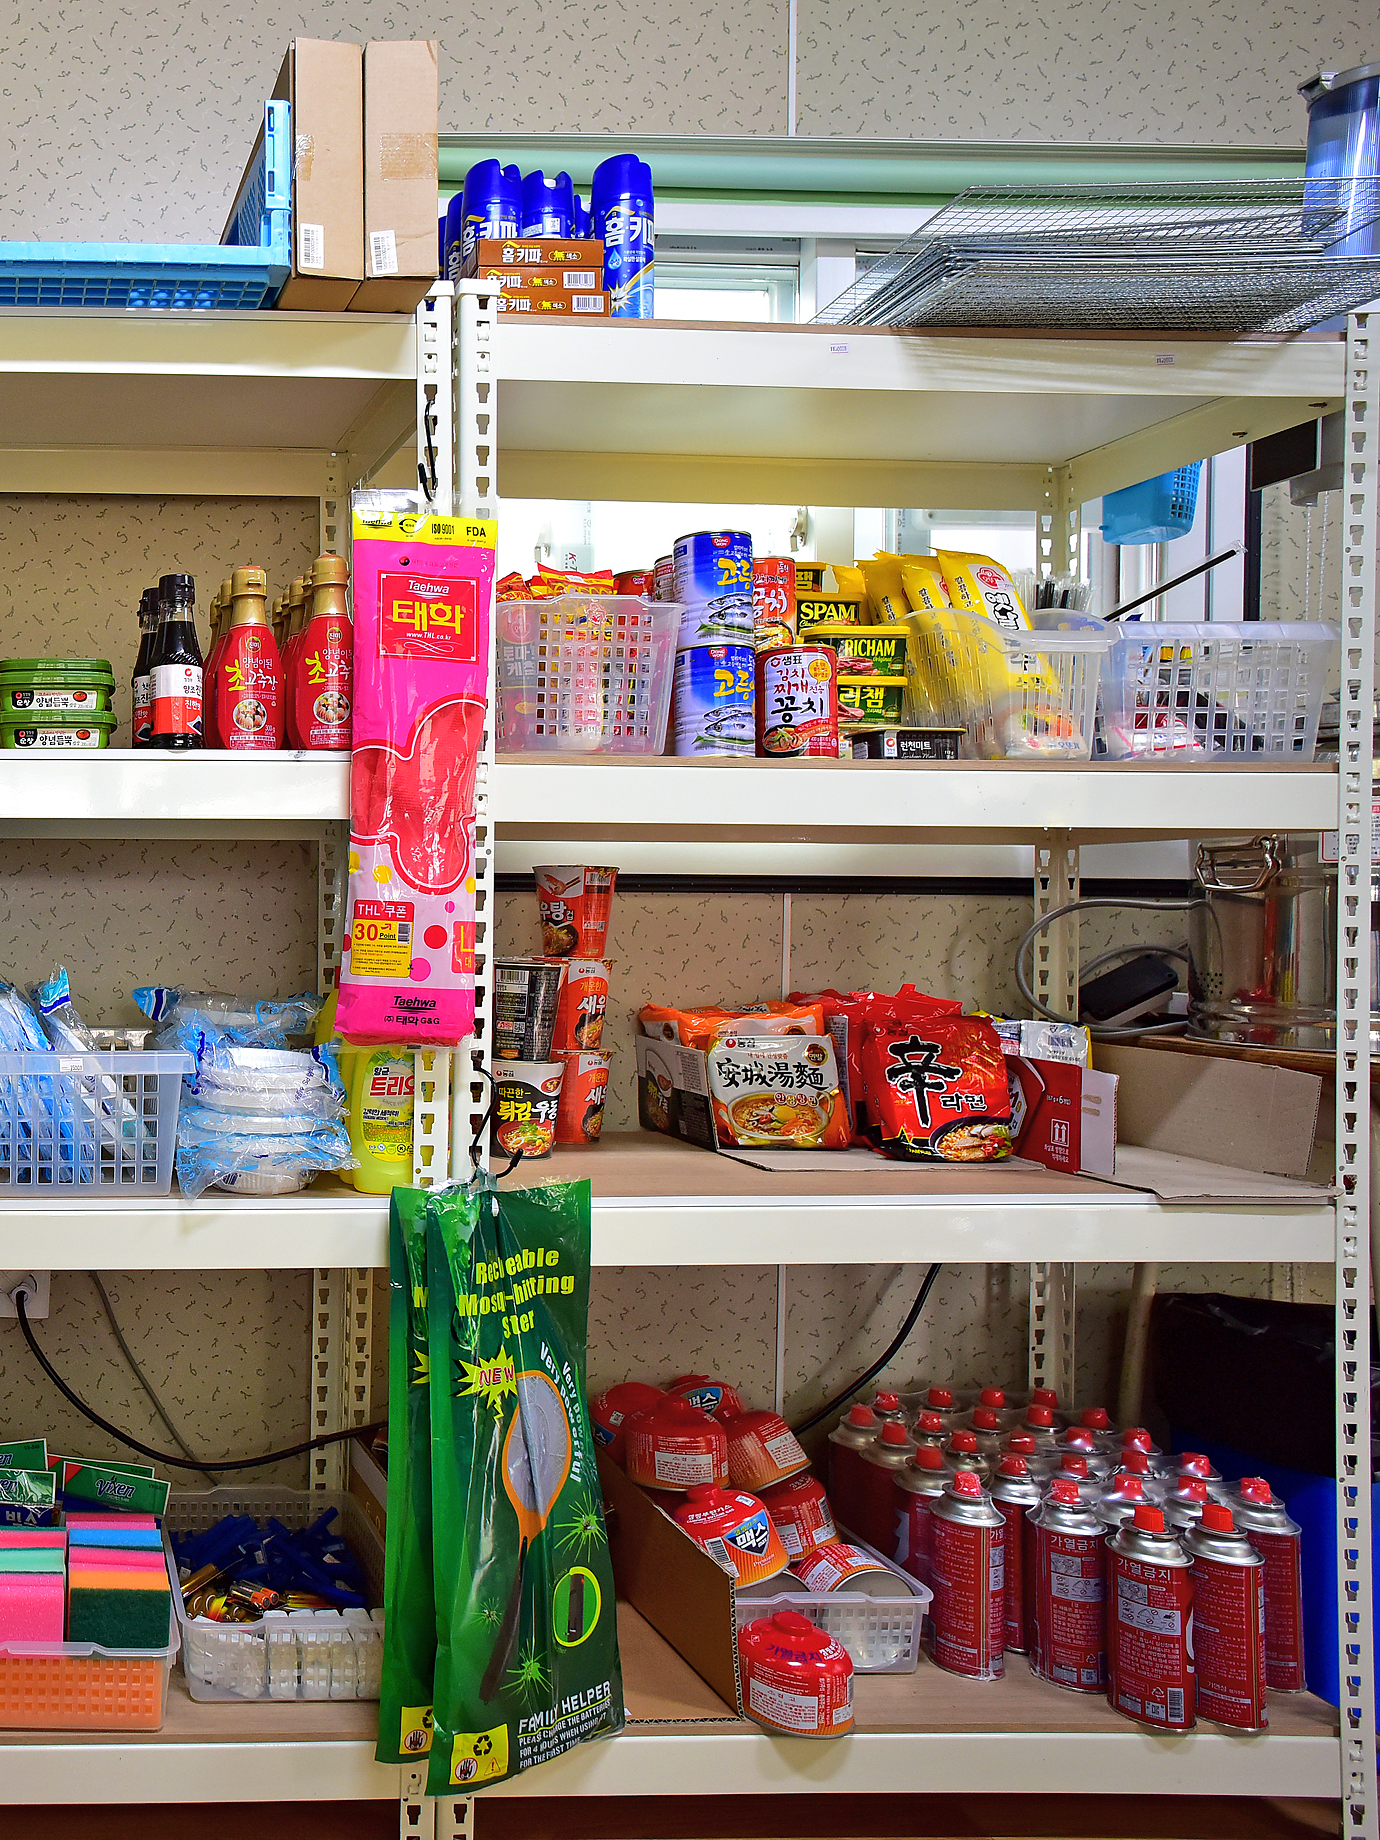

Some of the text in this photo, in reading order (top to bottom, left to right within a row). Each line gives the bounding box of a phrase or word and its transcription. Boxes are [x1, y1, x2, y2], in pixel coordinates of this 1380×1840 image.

[502, 248, 542, 264] 홈·키파
[431, 523, 487, 538] ISO 9001 FDA
[716, 557, 754, 591] 고등
[408, 580, 450, 594] Taehwa
[392, 600, 465, 635] 태화
[800, 602, 856, 622] SPAM
[406, 632, 452, 641] www.THL.co.kr
[844, 638, 897, 658] RICHAM
[242, 657, 273, 670] 양념이된
[782, 654, 803, 665] 샘표
[776, 668, 806, 680] 김치
[182, 684, 202, 697] 양조진
[774, 680, 808, 695] 찌개
[840, 686, 885, 708] 리챔
[770, 695, 824, 724] 꽁치
[900, 740, 934, 752] 런천미트
[358, 904, 407, 919] THL 쿠폰
[540, 900, 567, 922] 우탕
[354, 923, 397, 942] 30 Point
[580, 981, 606, 992] 개운한!
[393, 996, 437, 1008] Taehwa
[576, 994, 606, 1016] 새우
[396, 1016, 420, 1026] 태화
[420, 1016, 440, 1025] G&G
[370, 1076, 414, 1096] 트리오
[884, 1034, 964, 1128] 辛
[939, 1092, 988, 1113] 라면
[478, 1364, 514, 1387] NEW
[95, 1476, 136, 1498] Vixen
[735, 1522, 769, 1550] 맥스
[1050, 1534, 1099, 1552] 가열금지
[1118, 1558, 1171, 1582] 가열금지
[518, 1680, 611, 1734] FAMILY HELPER
[567, 1715, 580, 1727] THE
[520, 1746, 532, 1759] FOR
[560, 1726, 580, 1741] WHEN
[520, 1758, 532, 1768] FOR
[533, 1754, 546, 1764] THE
